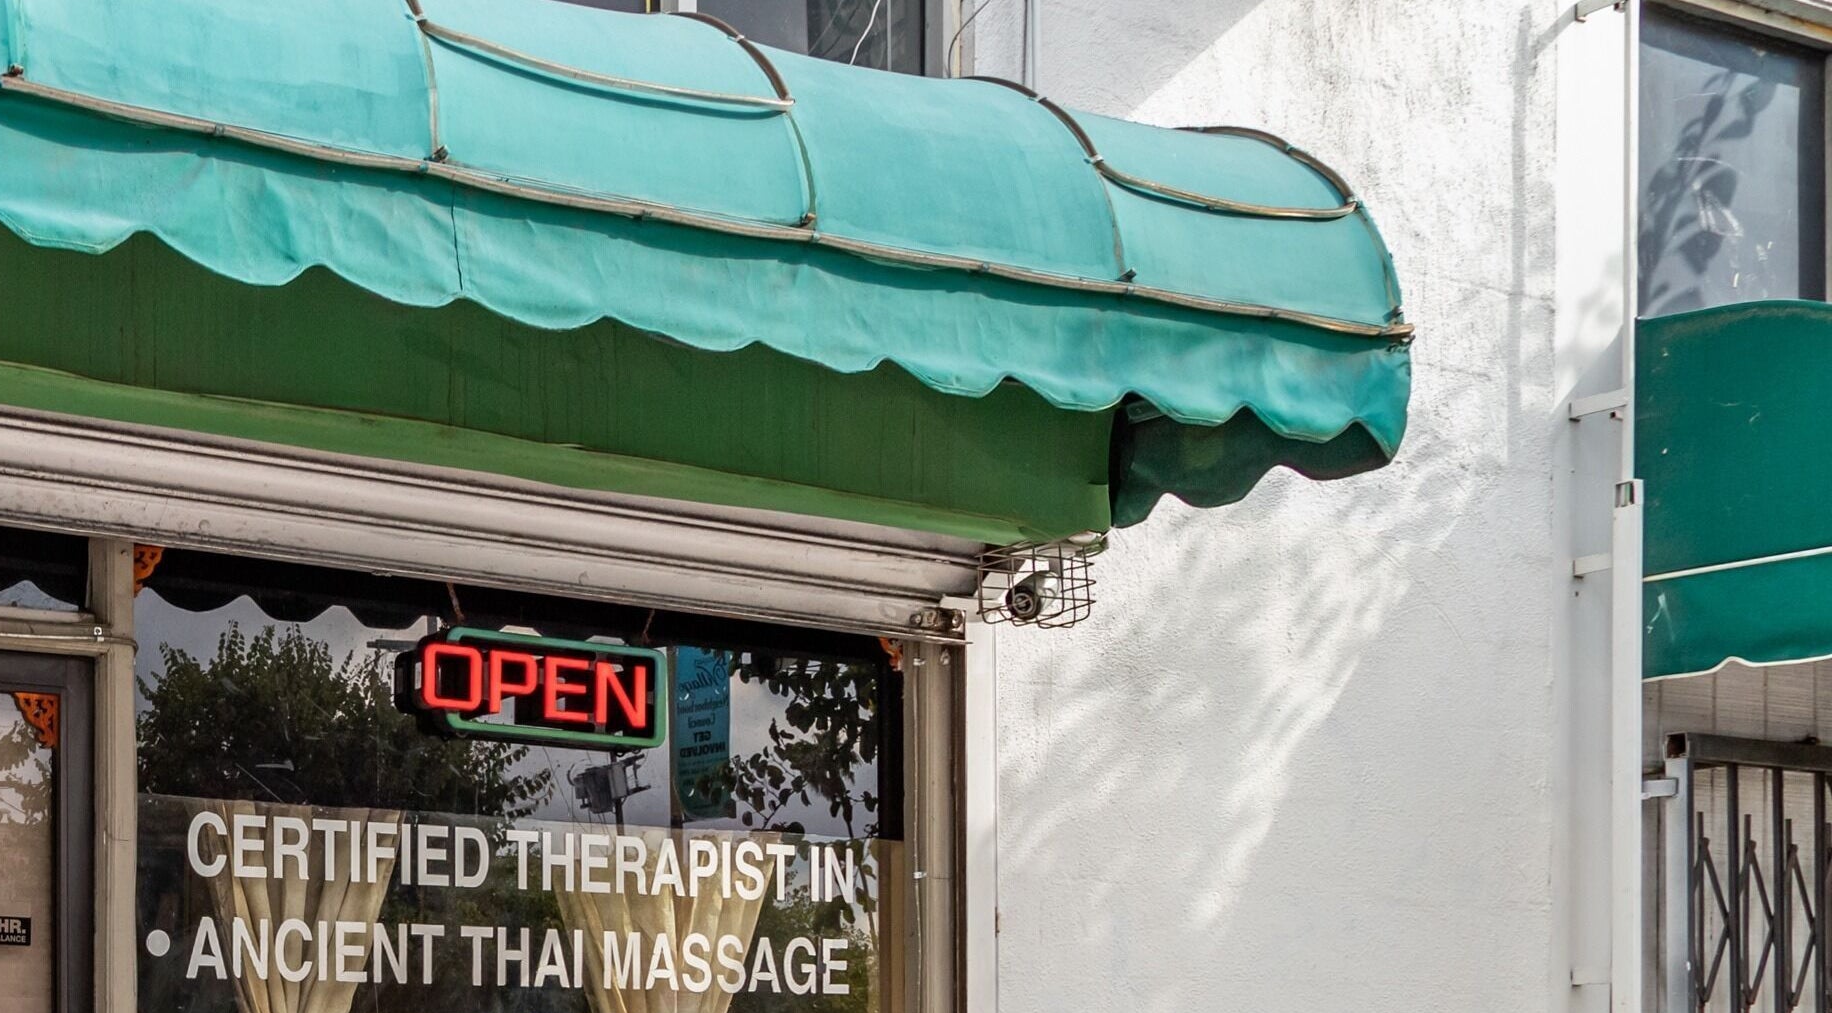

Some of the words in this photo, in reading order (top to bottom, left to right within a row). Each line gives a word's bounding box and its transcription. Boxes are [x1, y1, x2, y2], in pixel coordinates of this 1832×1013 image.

[423, 643, 647, 729] OPEN
[187, 811, 490, 888] CERTIFIED
[506, 830, 795, 901] THERAPIST
[810, 845, 854, 903] IN
[186, 916, 445, 985] ANCIENT
[460, 925, 584, 988] THAI
[603, 930, 850, 995] MASSAGE
